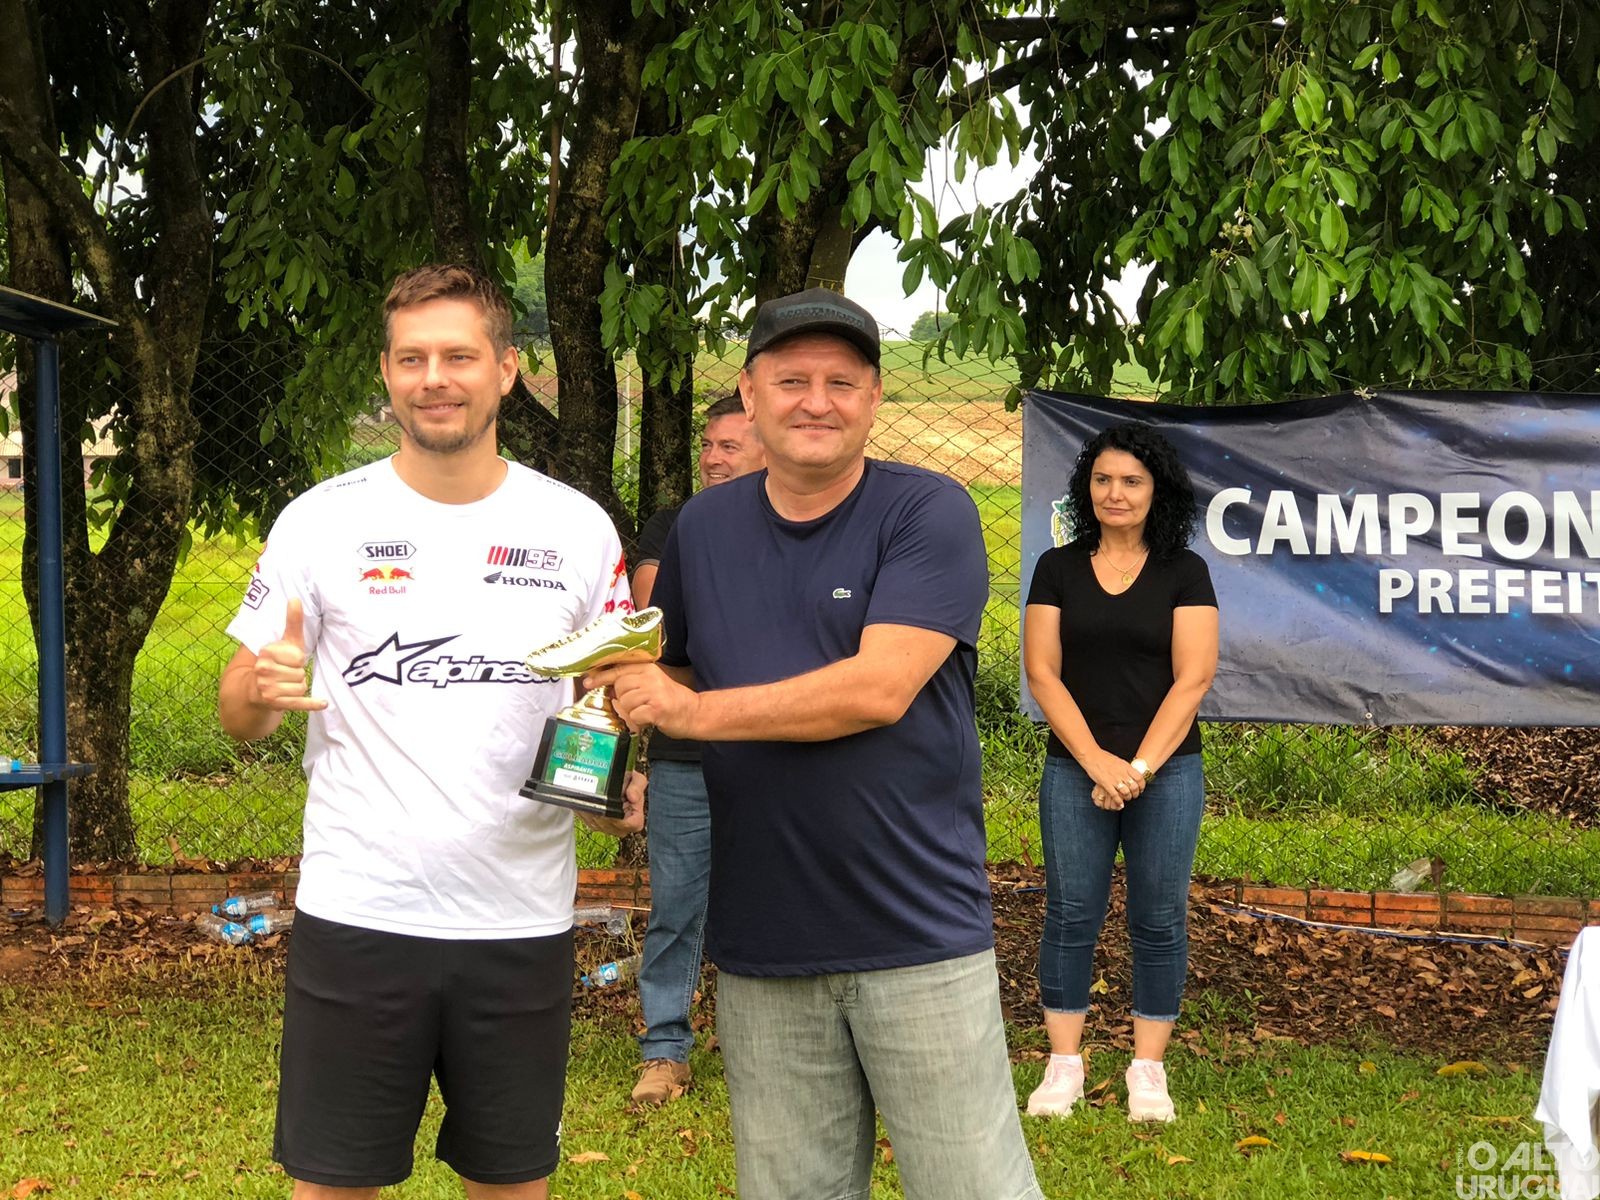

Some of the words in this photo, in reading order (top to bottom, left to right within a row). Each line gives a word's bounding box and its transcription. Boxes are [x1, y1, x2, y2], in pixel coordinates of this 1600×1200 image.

[1205, 487, 1600, 560] CAMPEON
[365, 544, 408, 558] SHOEI
[525, 548, 564, 571] 93
[369, 586, 387, 595] Red
[389, 586, 406, 594] Bull
[502, 576, 568, 591] HONDA
